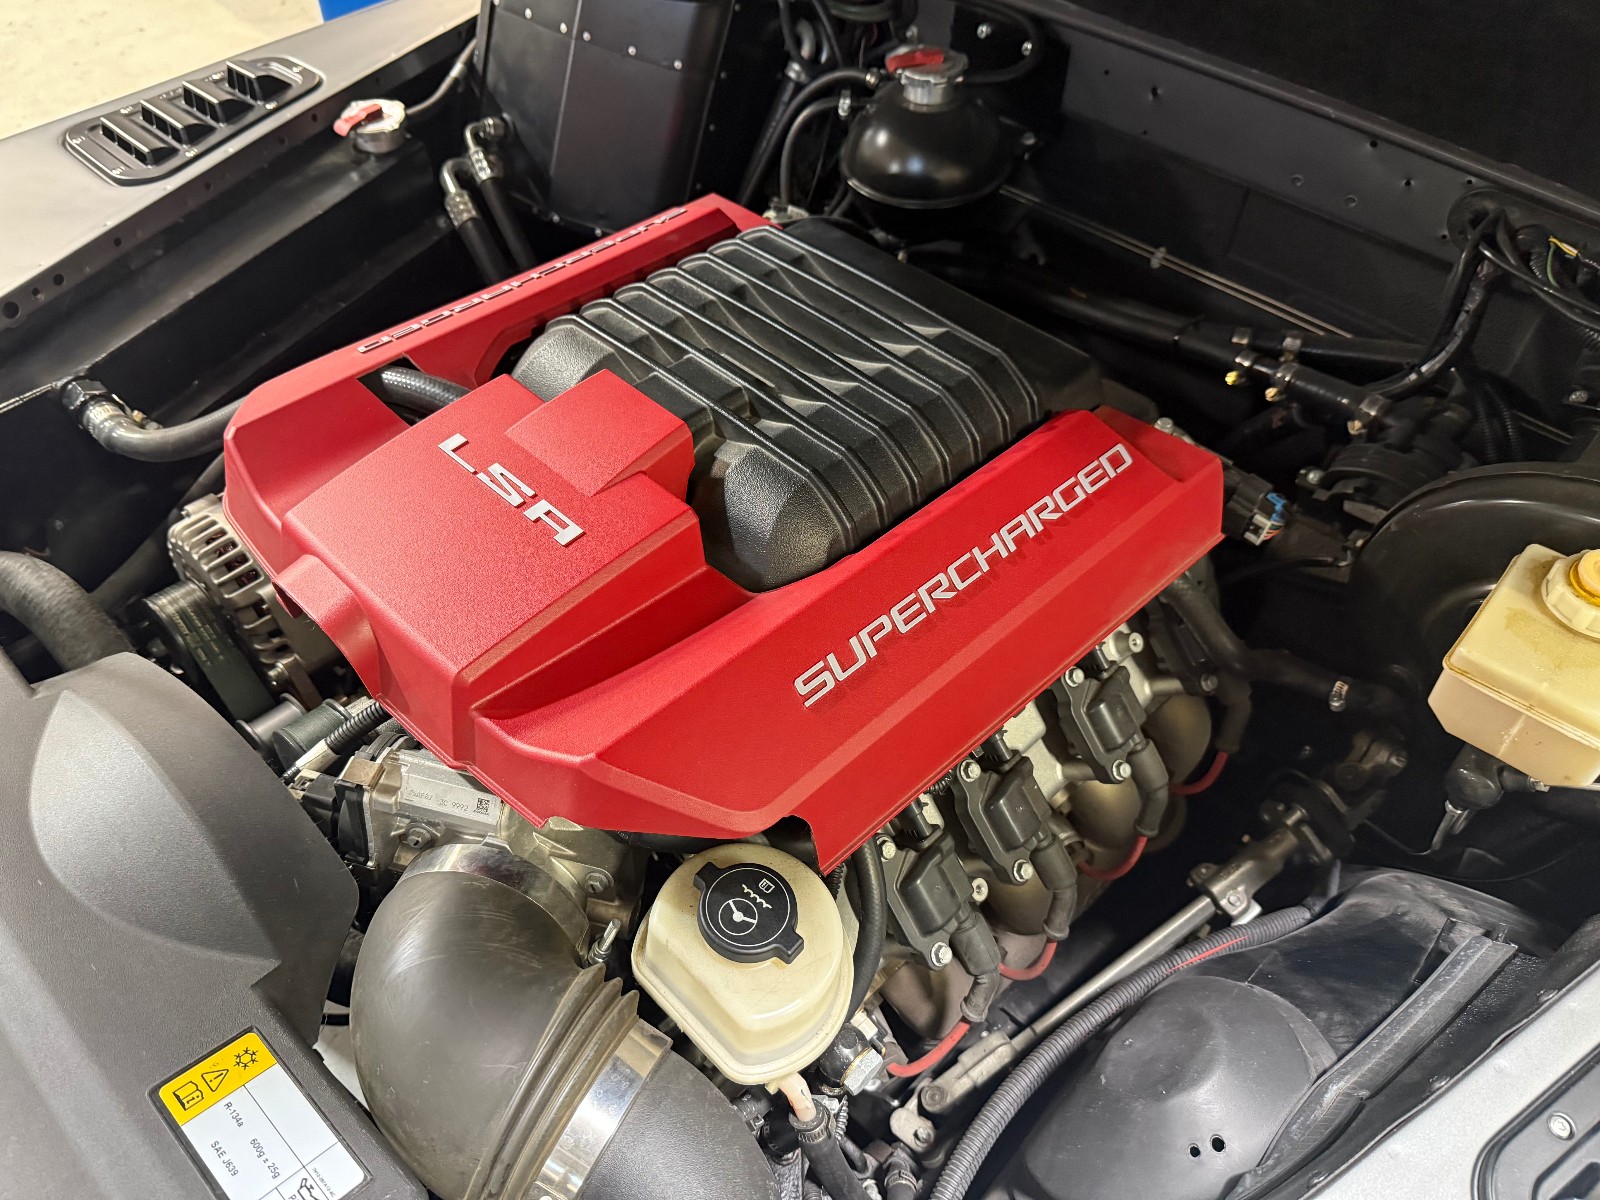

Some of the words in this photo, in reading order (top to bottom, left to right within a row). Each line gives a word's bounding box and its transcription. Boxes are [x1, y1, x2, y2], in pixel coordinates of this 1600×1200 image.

[438, 433, 585, 546] LSA
[794, 443, 1133, 708] SUPERCHARGED
[210, 1140, 226, 1159] SAE
[222, 1155, 239, 1177] J639
[223, 1101, 244, 1128] R-134a
[250, 1137, 265, 1159] 600g
[267, 1162, 281, 1180] 25g
